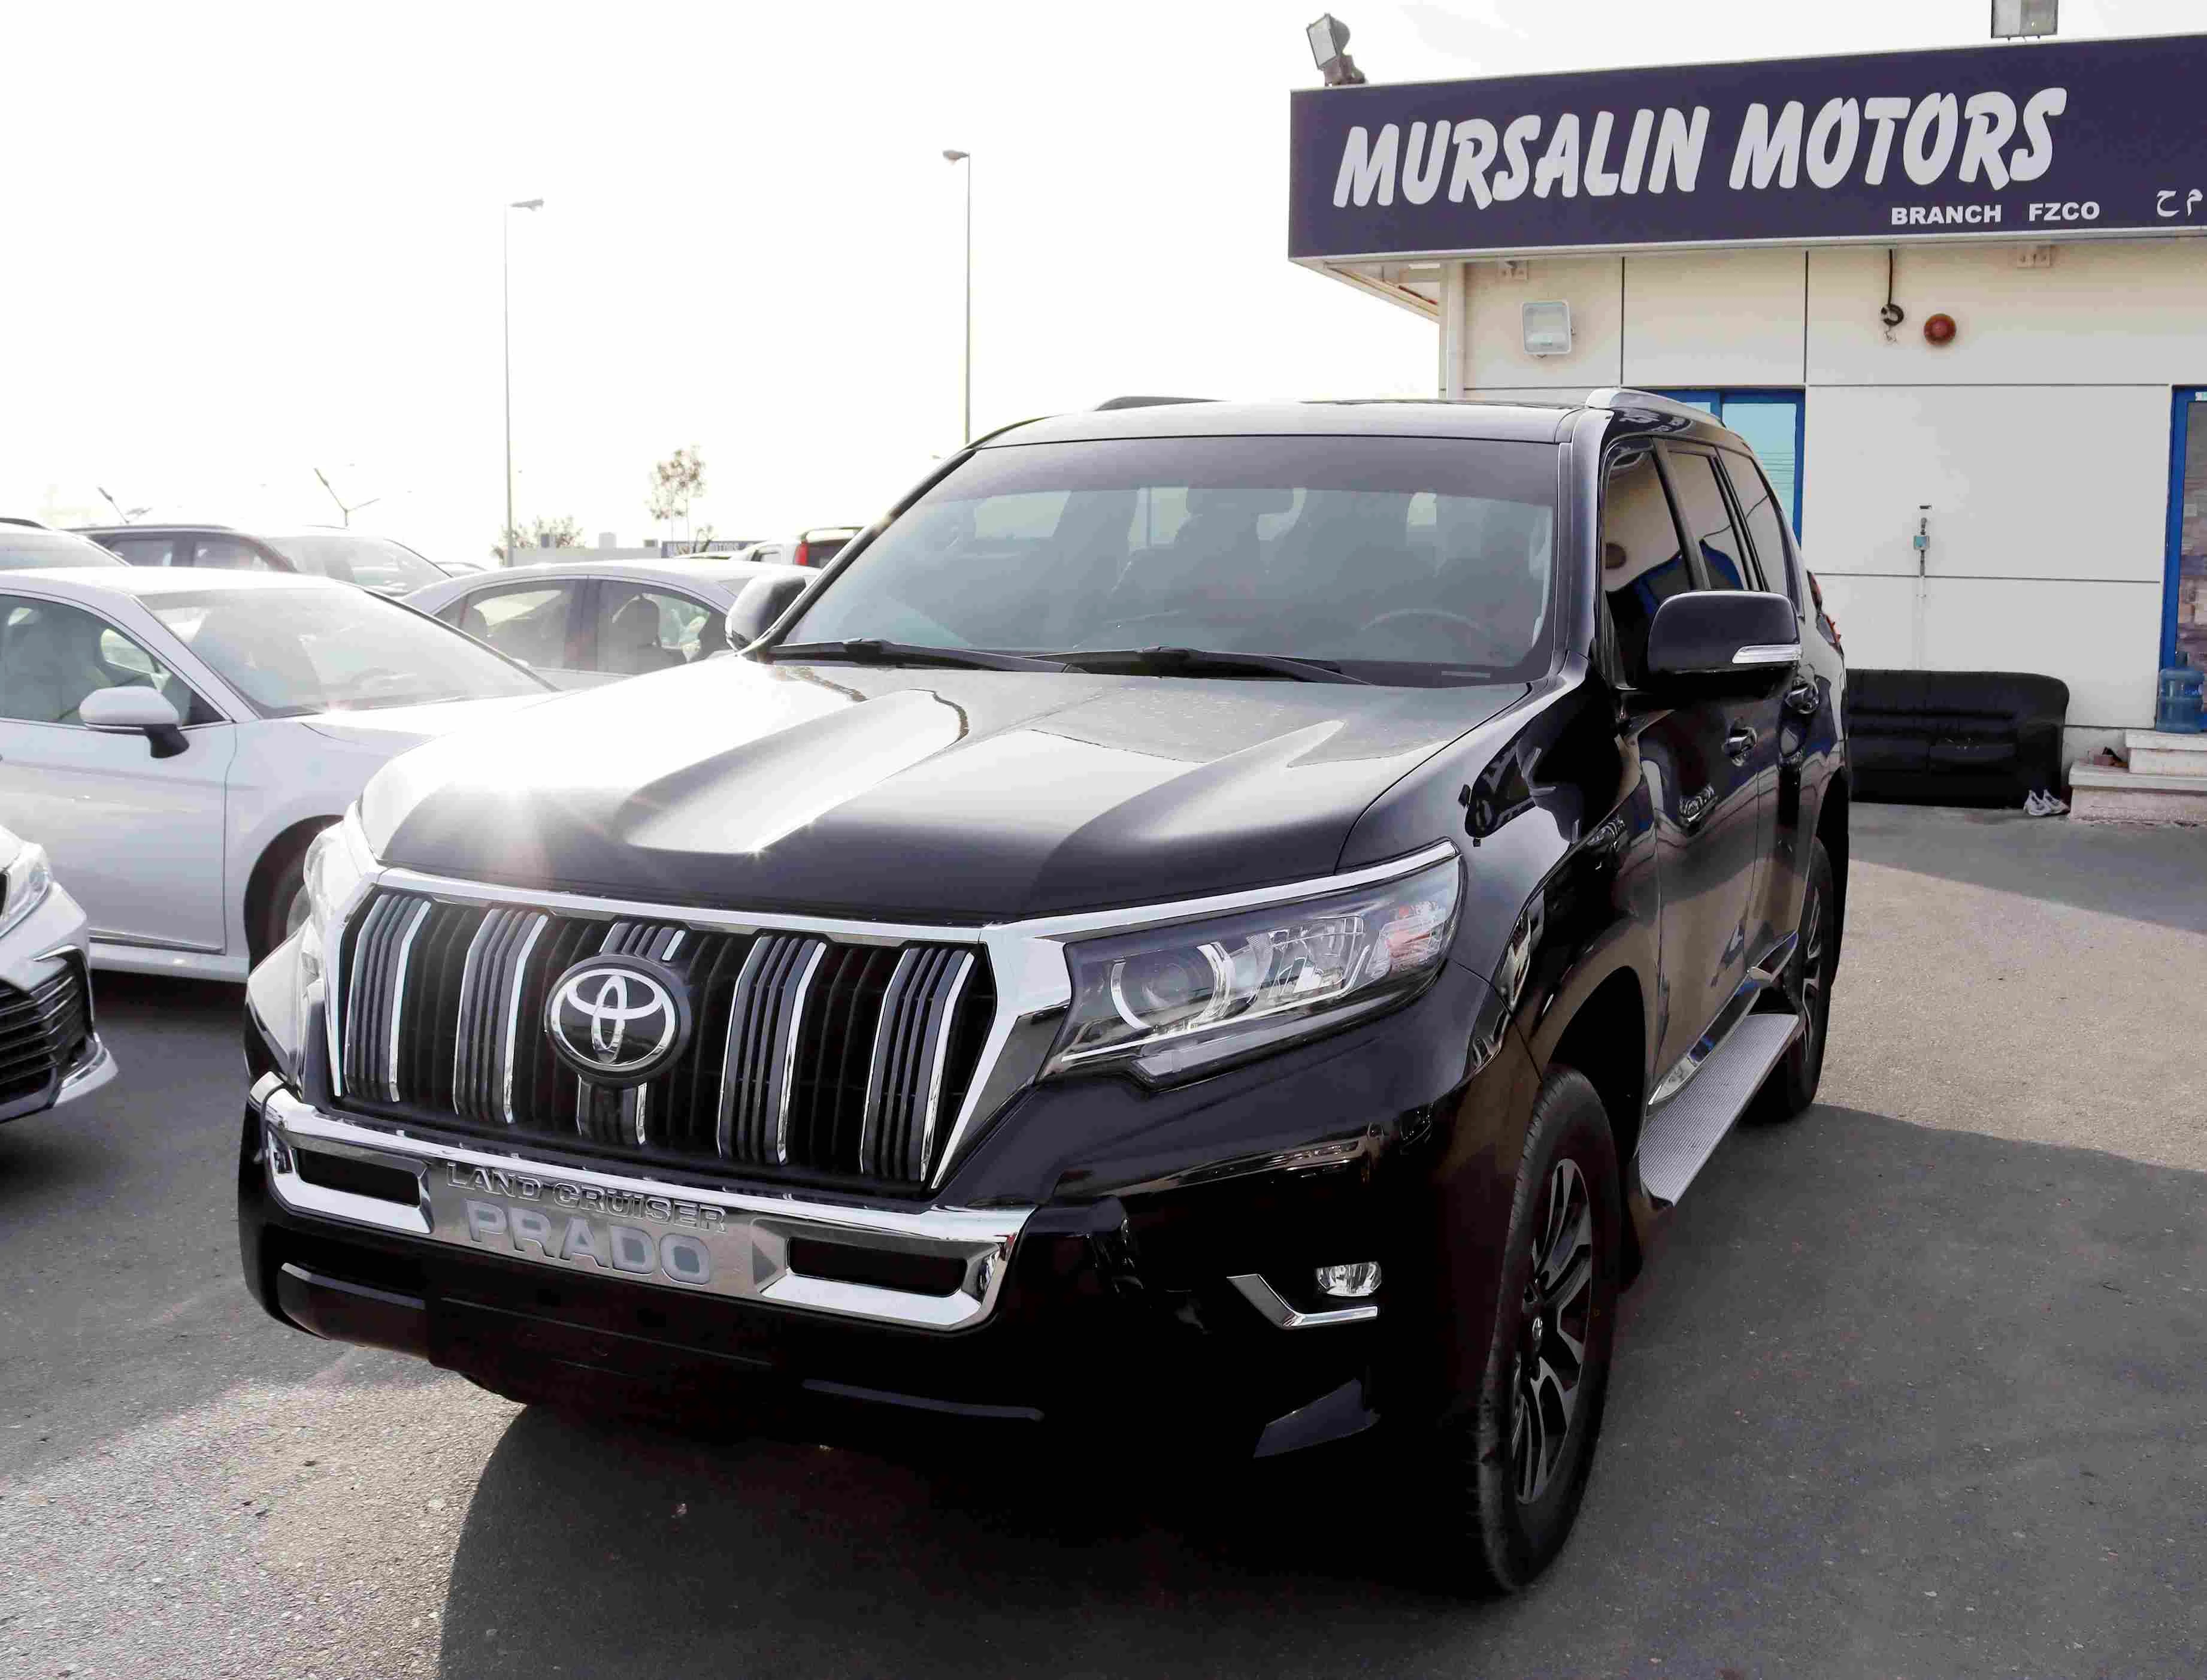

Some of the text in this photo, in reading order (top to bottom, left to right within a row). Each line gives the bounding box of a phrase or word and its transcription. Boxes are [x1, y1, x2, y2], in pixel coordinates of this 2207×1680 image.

[1333, 87, 2067, 210] MURSALIN MOTORS
[1891, 201, 2100, 225] BRANCH FZCO
[446, 1162, 729, 1234] LAND CRUISER
[464, 1198, 712, 1287] PRADO
